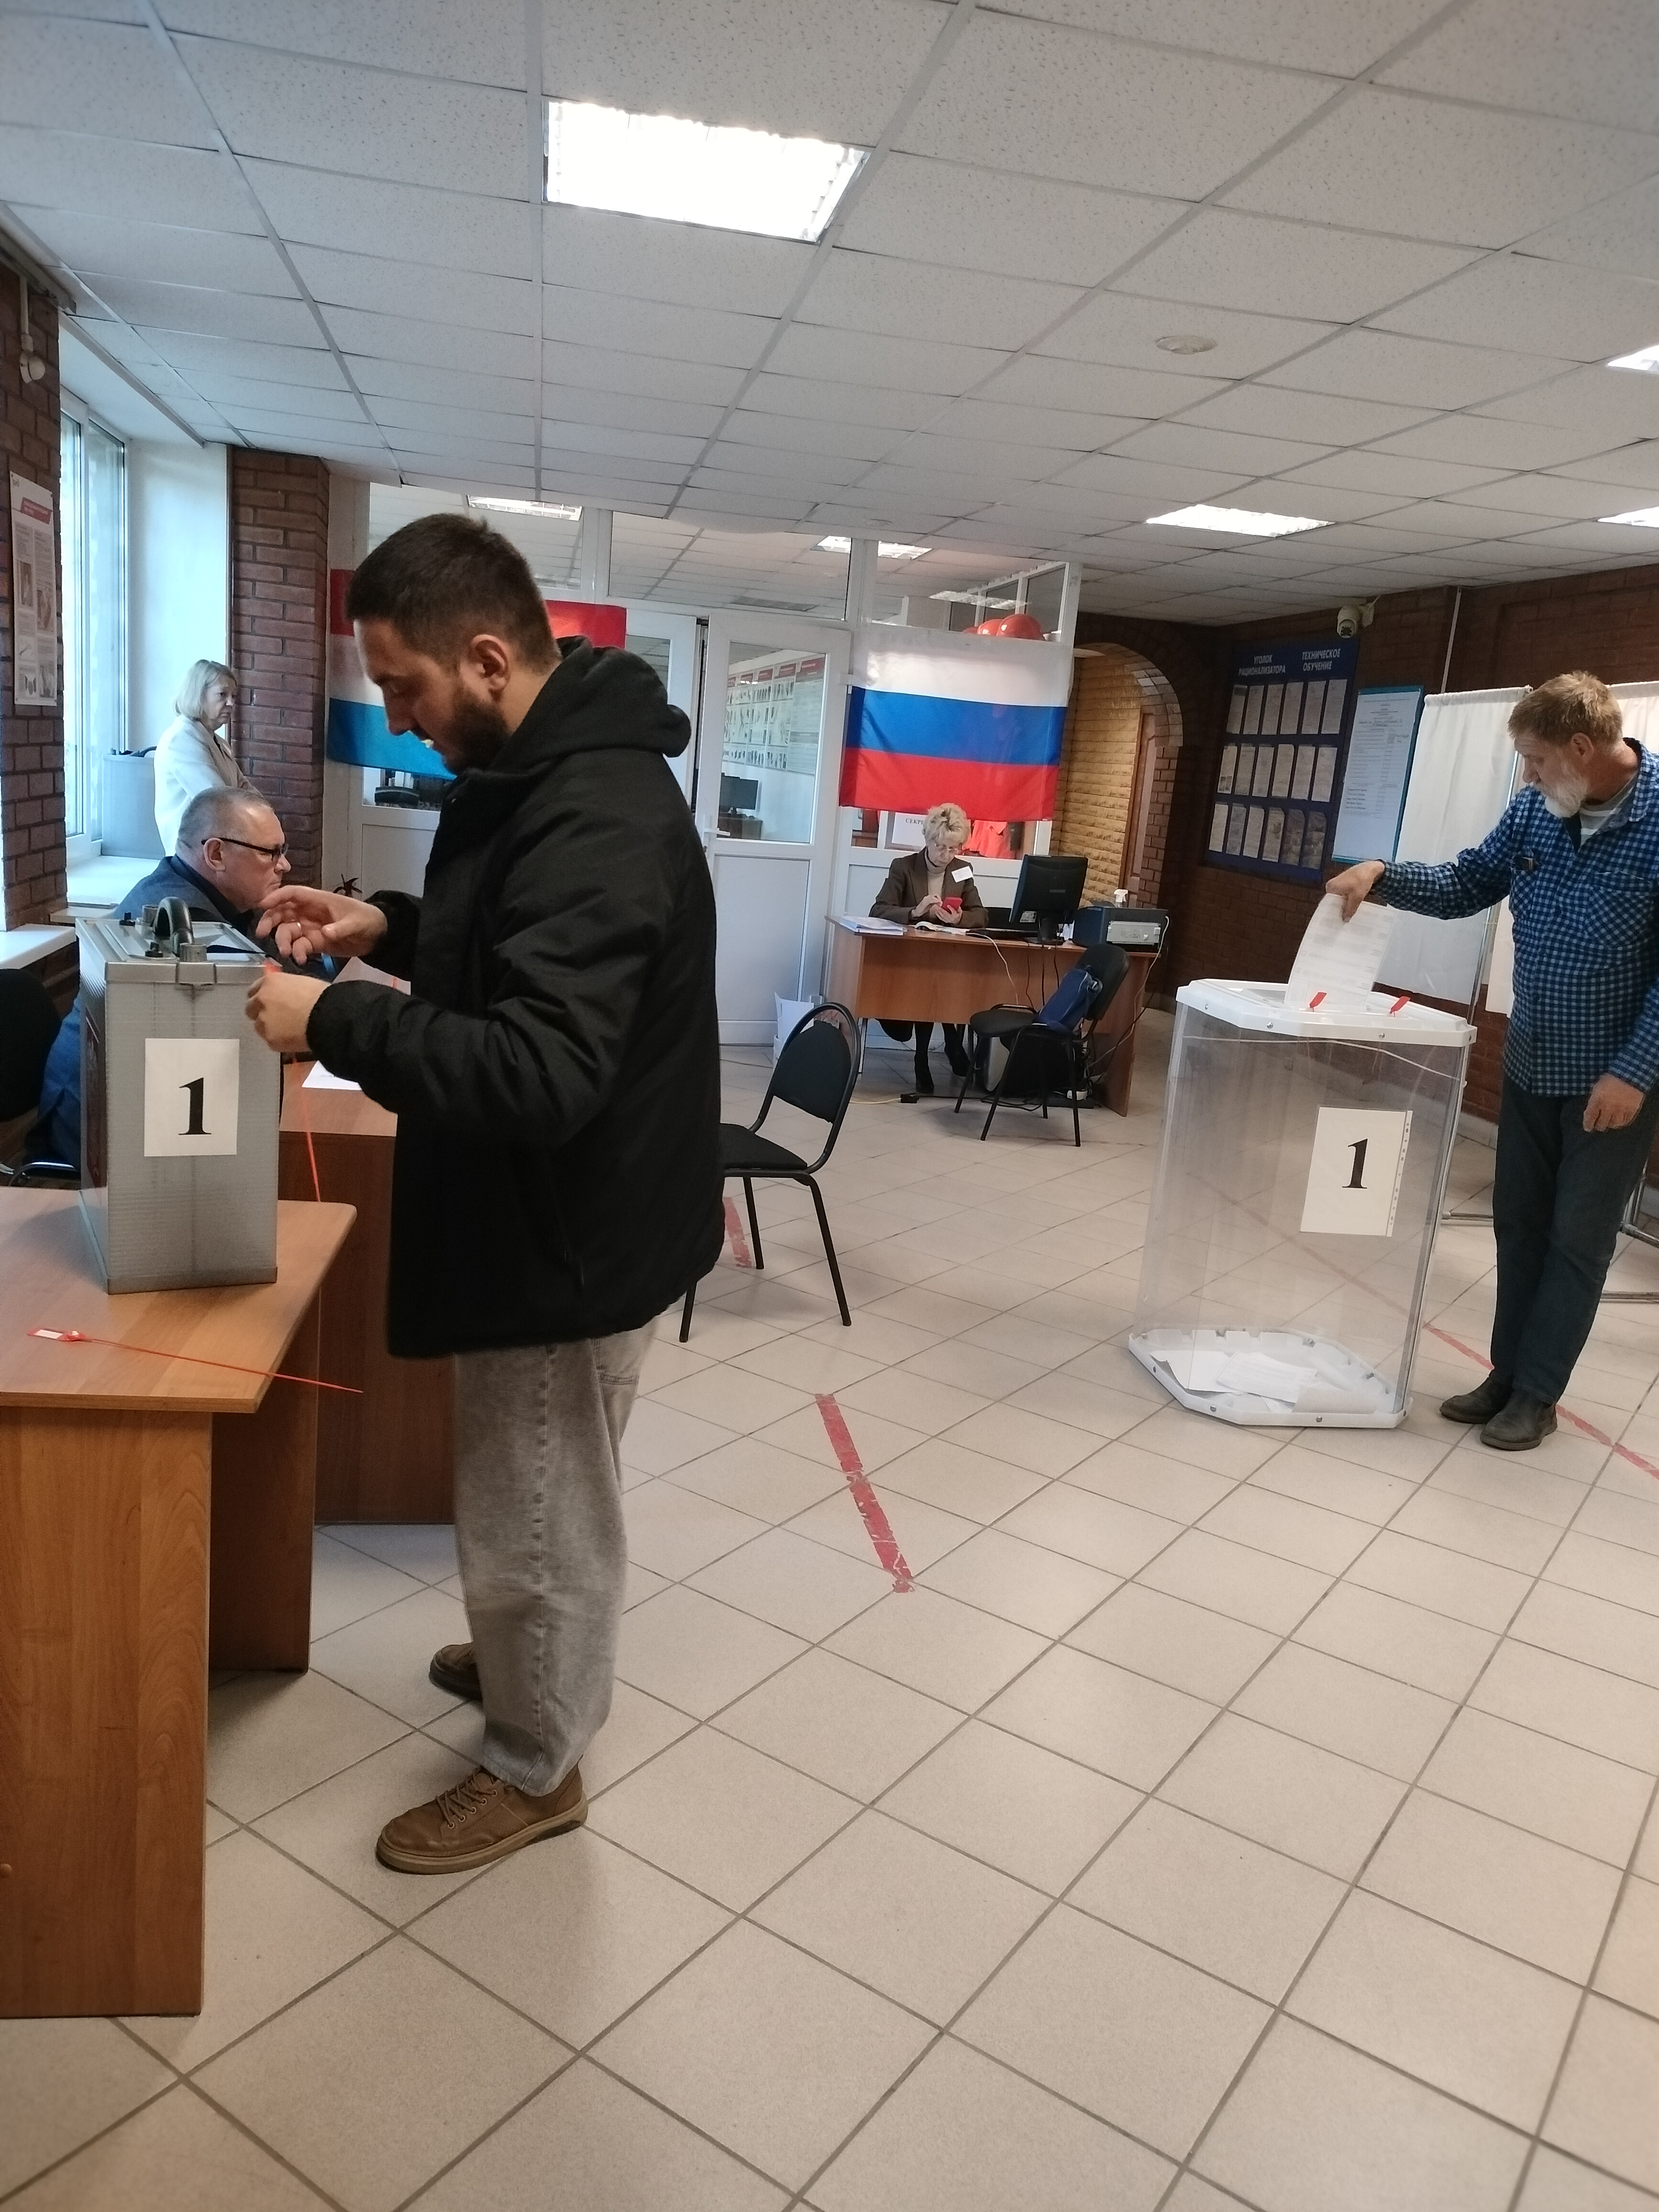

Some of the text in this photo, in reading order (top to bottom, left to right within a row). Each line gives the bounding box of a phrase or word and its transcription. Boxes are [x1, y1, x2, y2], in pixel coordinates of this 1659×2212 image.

[1254, 654, 1273, 664] УГОЛОК
[1302, 648, 1341, 661] ТЕХНИЧЕСКОЕ
[1239, 664, 1286, 676] РАЦИОНАЛИЗАТОРА
[1303, 661, 1332, 672] ОБУЧЕНИЕ
[178, 1077, 212, 1135] 1
[1342, 1138, 1368, 1189] 1
